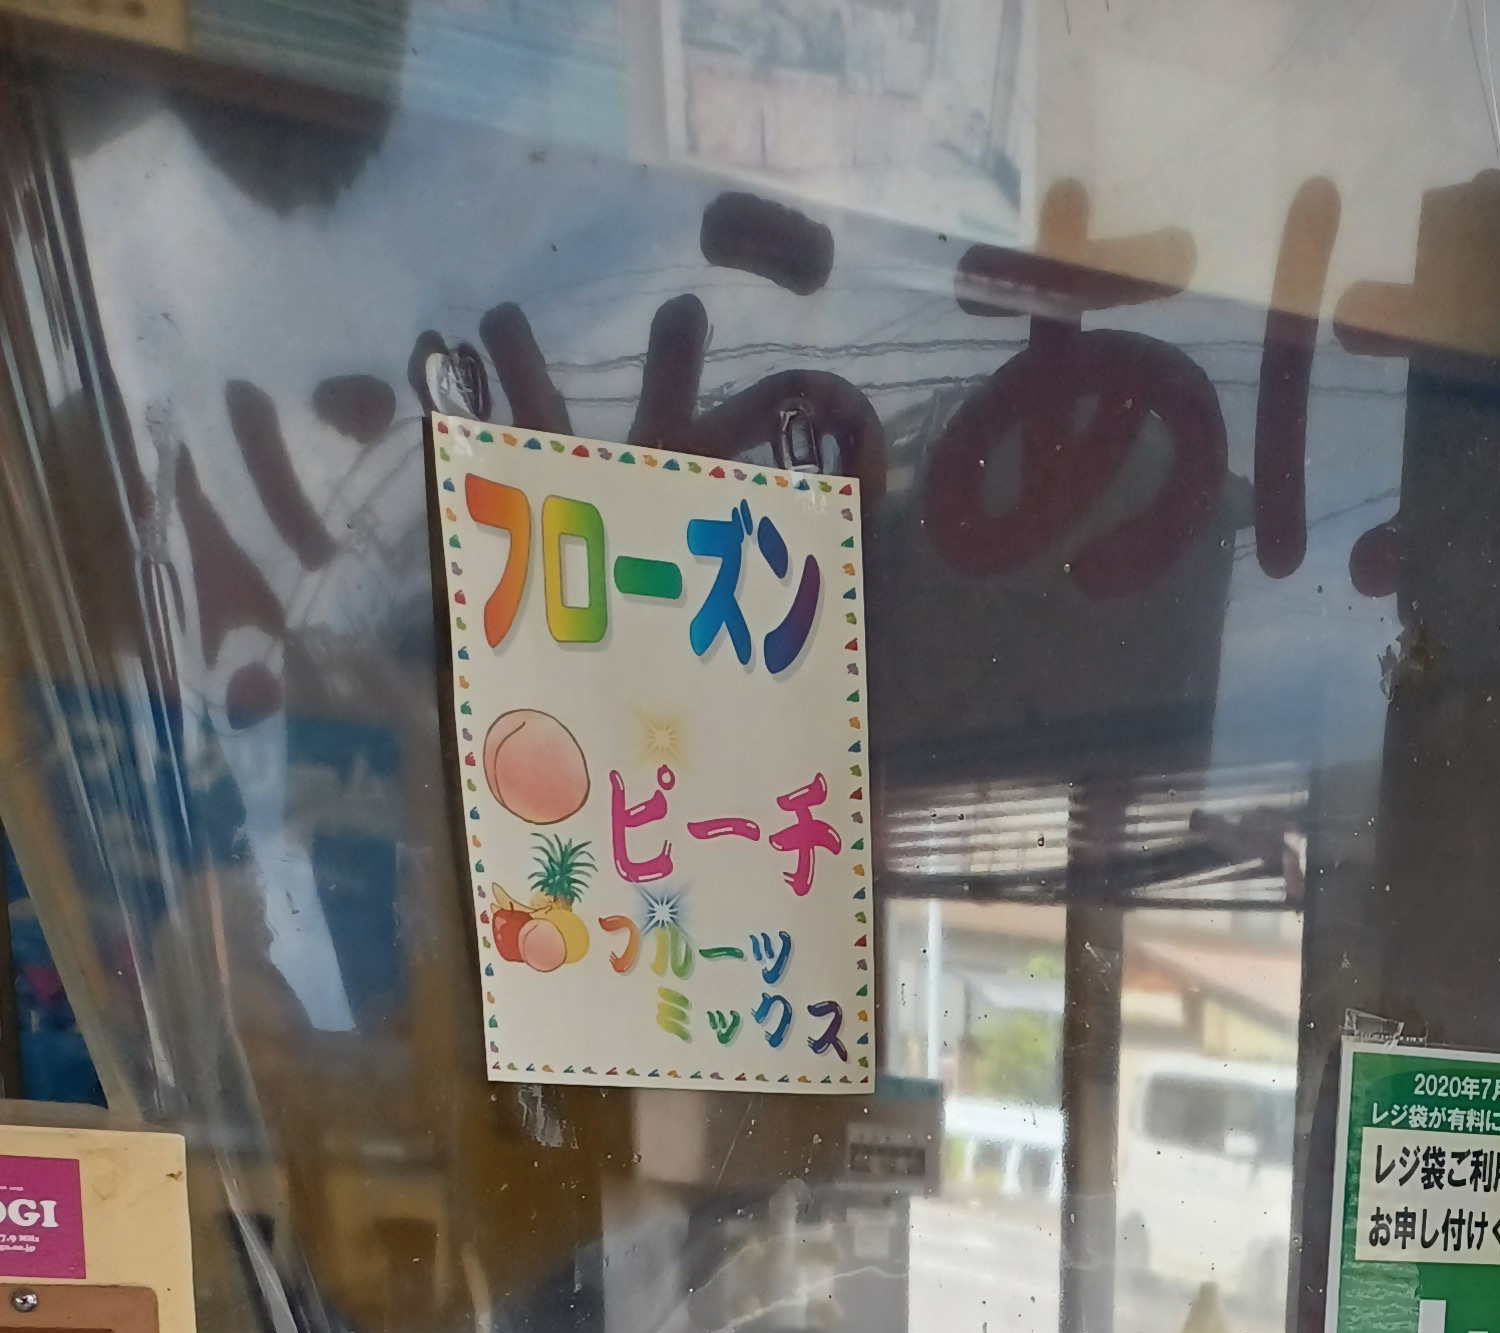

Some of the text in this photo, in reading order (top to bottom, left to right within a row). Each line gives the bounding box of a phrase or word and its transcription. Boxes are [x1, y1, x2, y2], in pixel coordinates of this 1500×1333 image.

[465, 472, 820, 674] フローズン
[609, 764, 842, 896] ピーチ
[599, 914, 792, 985] フルーツ
[656, 985, 848, 1062] ミックス
[0, 1198, 59, 1228] GI
